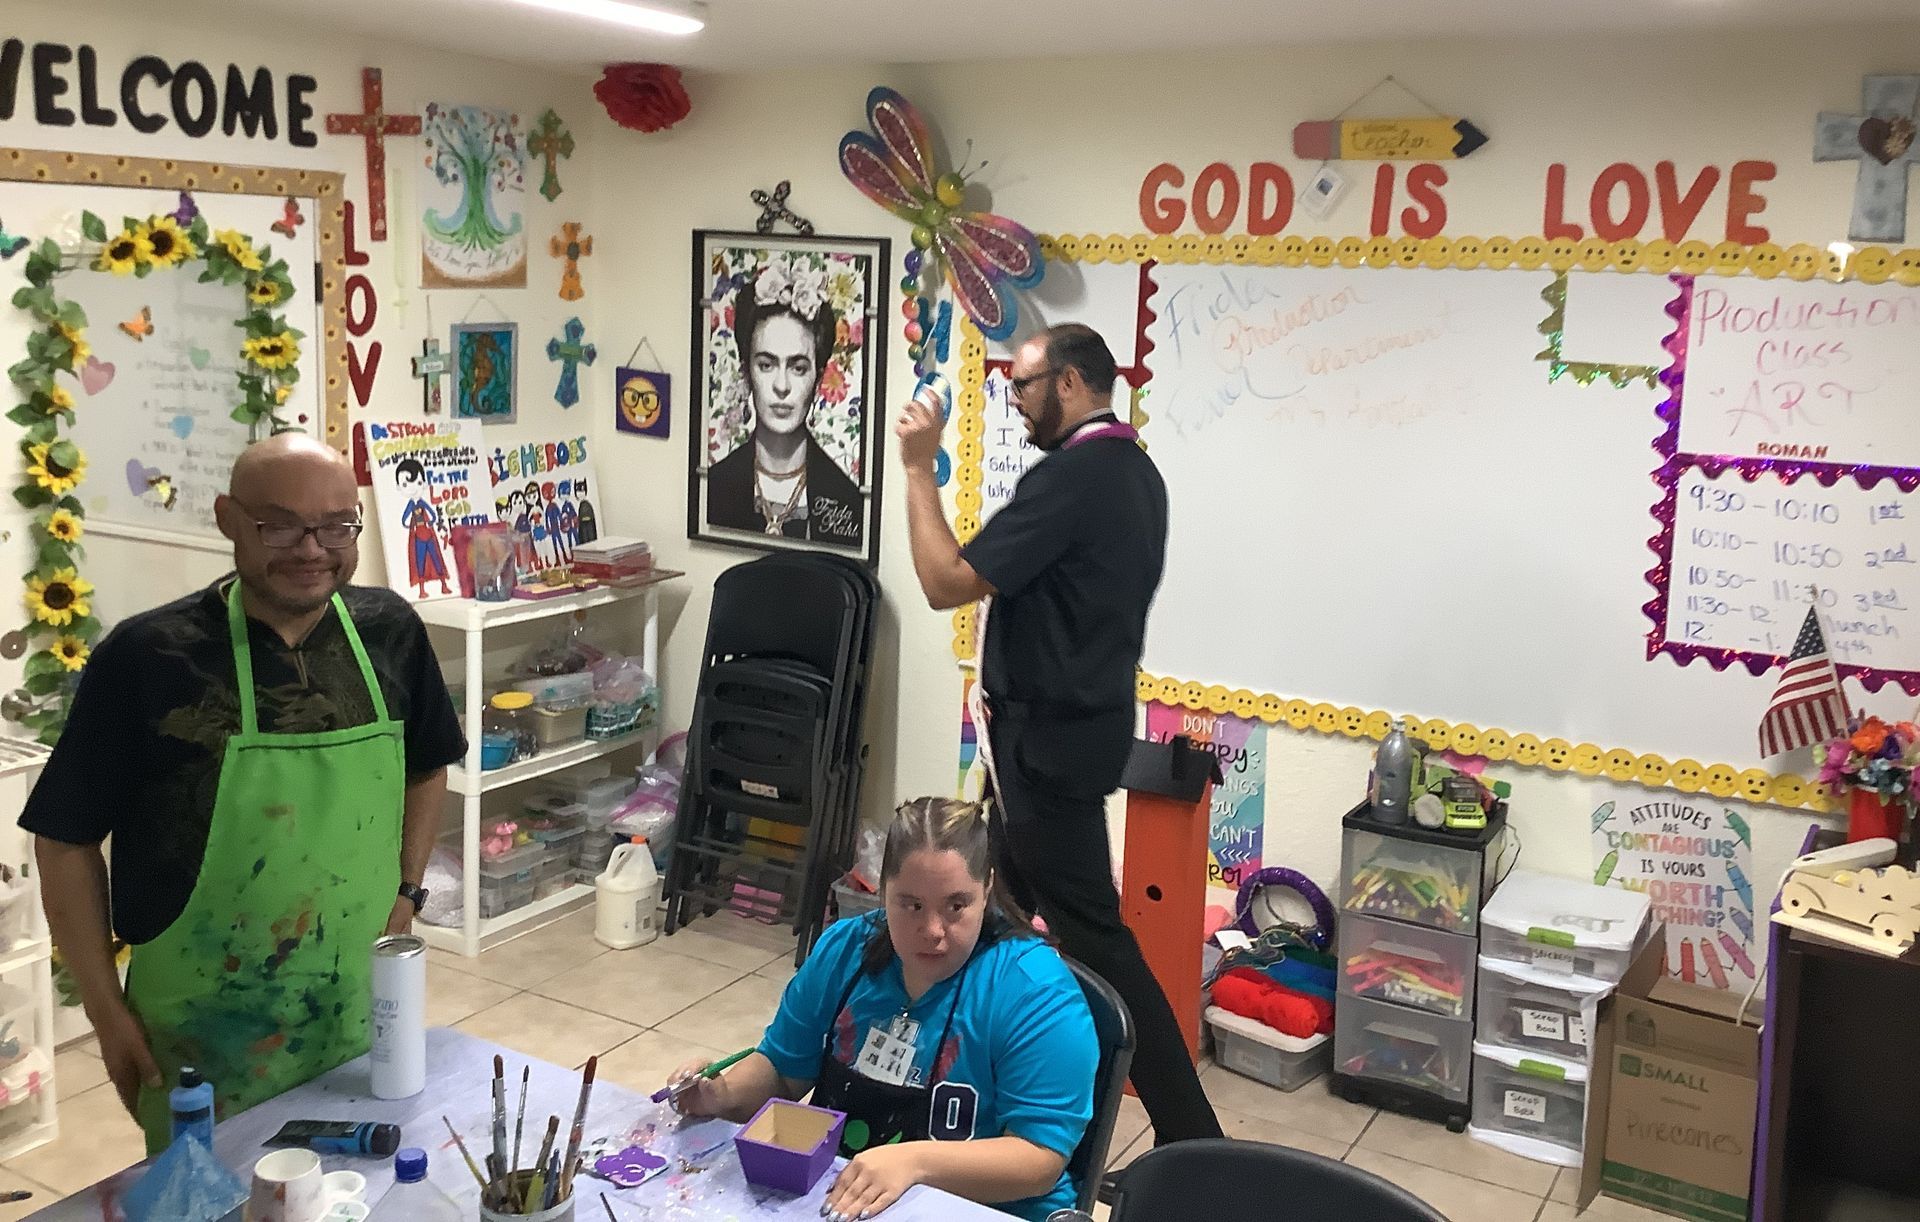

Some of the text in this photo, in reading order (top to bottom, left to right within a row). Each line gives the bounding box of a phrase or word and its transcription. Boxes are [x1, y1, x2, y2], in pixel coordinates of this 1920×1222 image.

[1139, 159, 1777, 245] GOD IS LOVE
[1756, 443, 1829, 459] ROMAN
[1183, 713, 1227, 738] DON'T
[1629, 802, 1712, 830] ATTITUDES
[1641, 859, 1706, 878] IS YOURS
[1644, 1061, 1709, 1093] SMALL
